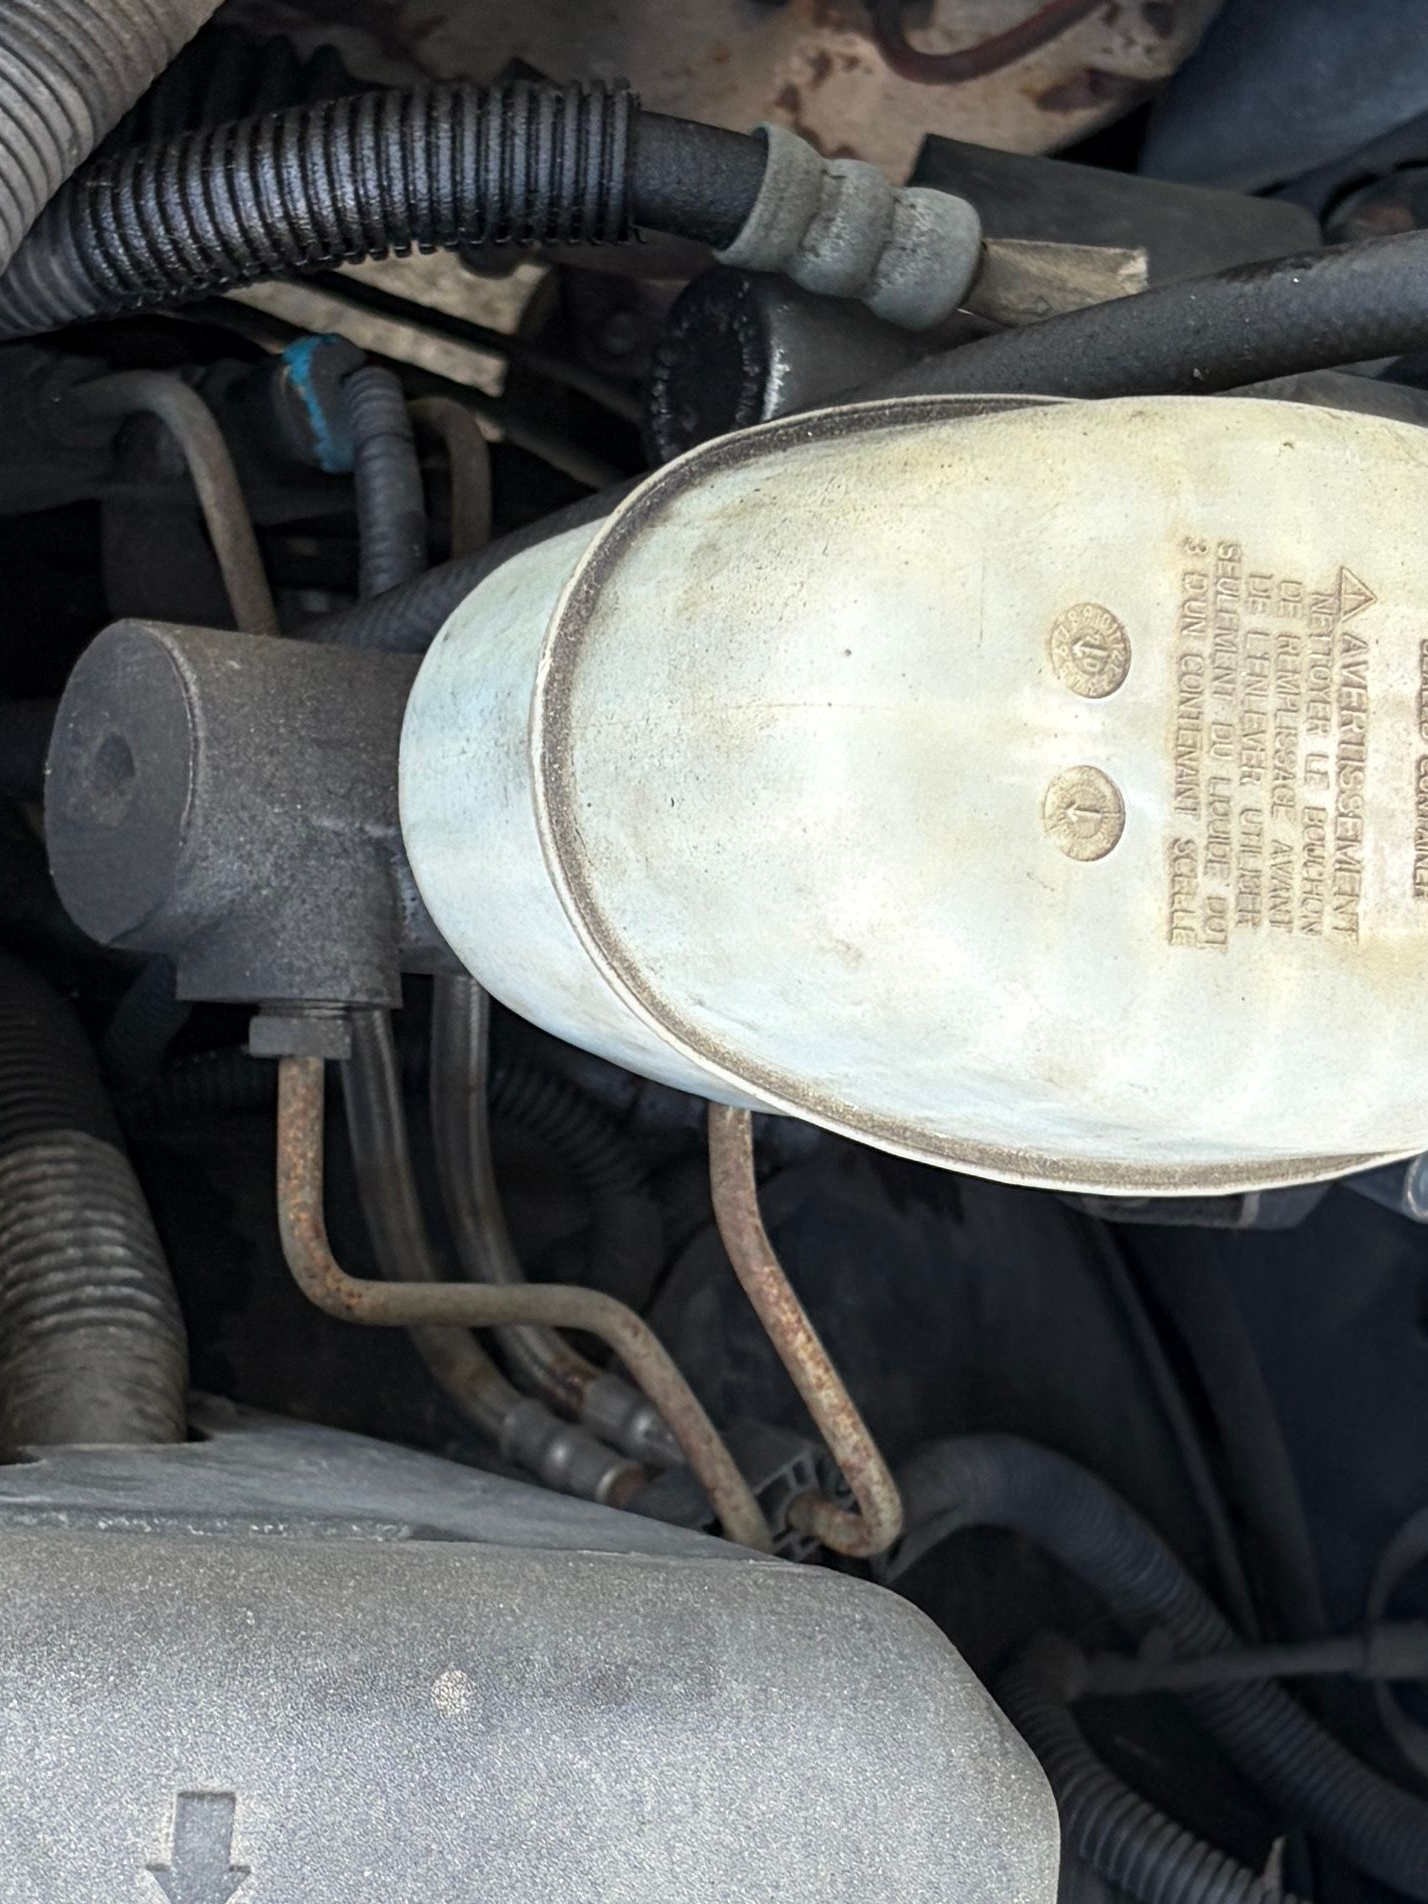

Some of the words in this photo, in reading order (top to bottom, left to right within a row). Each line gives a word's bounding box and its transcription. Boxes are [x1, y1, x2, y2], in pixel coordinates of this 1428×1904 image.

[1184, 540, 1207, 556] 3
[1246, 574, 1273, 616] DE
[1277, 581, 1303, 618] DE
[1210, 543, 1242, 700] SEULEMENT
[1307, 593, 1334, 735] NETTOYER
[1174, 654, 1204, 822] CONTENANT
[1210, 723, 1235, 760] DU
[1271, 634, 1301, 821] REMPLISSAGE
[1304, 754, 1330, 790] LE
[1204, 776, 1232, 880] LIQUIDE
[1332, 633, 1369, 944] AVERTISSEMENT
[1168, 838, 1198, 947] SCELLE
[1236, 809, 1263, 929] UTILISER
[1269, 839, 1294, 934] AVANT
[1301, 806, 1327, 936] BOUCHON
[1200, 897, 1228, 955] DOT
